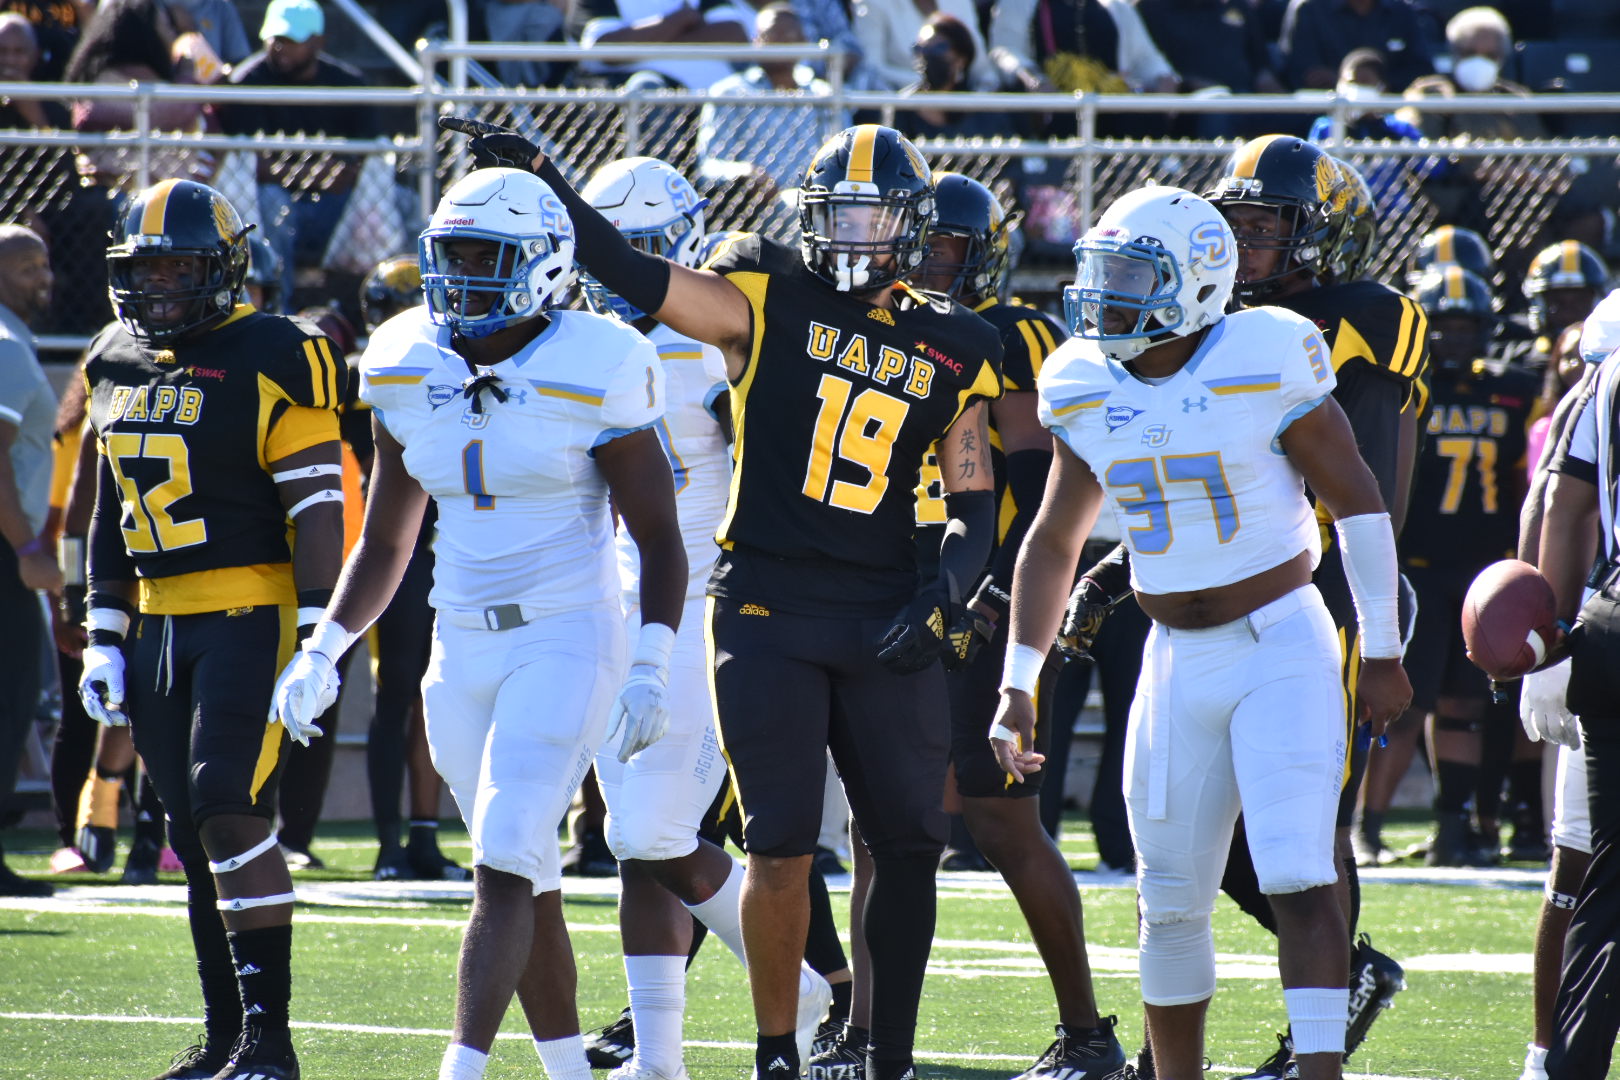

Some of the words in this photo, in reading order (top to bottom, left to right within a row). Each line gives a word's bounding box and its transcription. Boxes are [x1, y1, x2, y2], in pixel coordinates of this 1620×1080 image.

[1188, 221, 1231, 271] SU
[194, 367, 227, 379] SWAC
[806, 321, 936, 399] UAPB
[927, 347, 963, 373] SWAC
[107, 385, 204, 425] UAPB
[462, 439, 496, 511] 1
[802, 374, 910, 515] 19
[1437, 438, 1498, 514] 71
[105, 433, 207, 553] 52
[1105, 451, 1241, 556] 37
[739, 606, 770, 617] adidas
[693, 726, 717, 785] JAGUARS
